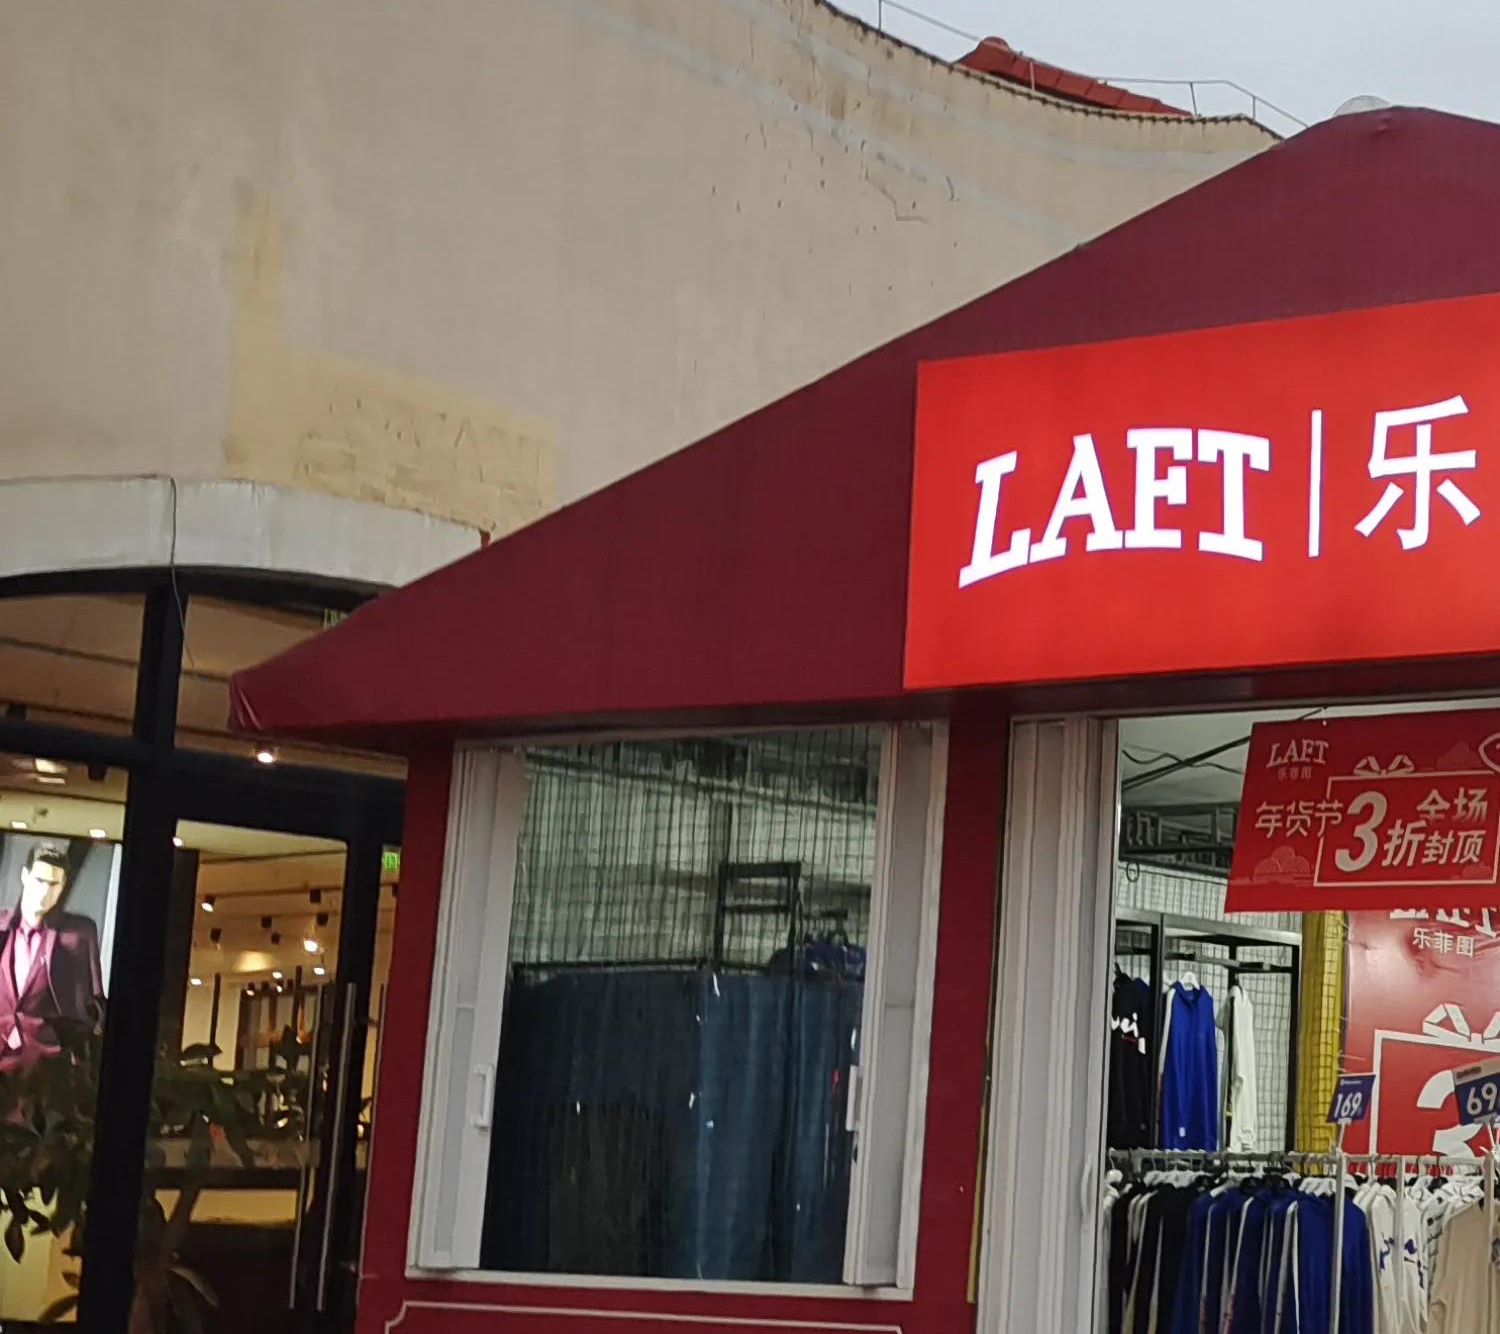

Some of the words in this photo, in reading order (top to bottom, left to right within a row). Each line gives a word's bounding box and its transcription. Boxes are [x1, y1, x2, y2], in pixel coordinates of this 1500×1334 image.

[958, 427, 1270, 590] LAFT
[1266, 738, 1329, 768] LAFT
[1254, 799, 1344, 839] 年货节
[1415, 787, 1488, 821] 全场
[1412, 926, 1476, 958] 乐菲图
[1333, 1091, 1363, 1119] 169
[1466, 1082, 1498, 1116] 69
